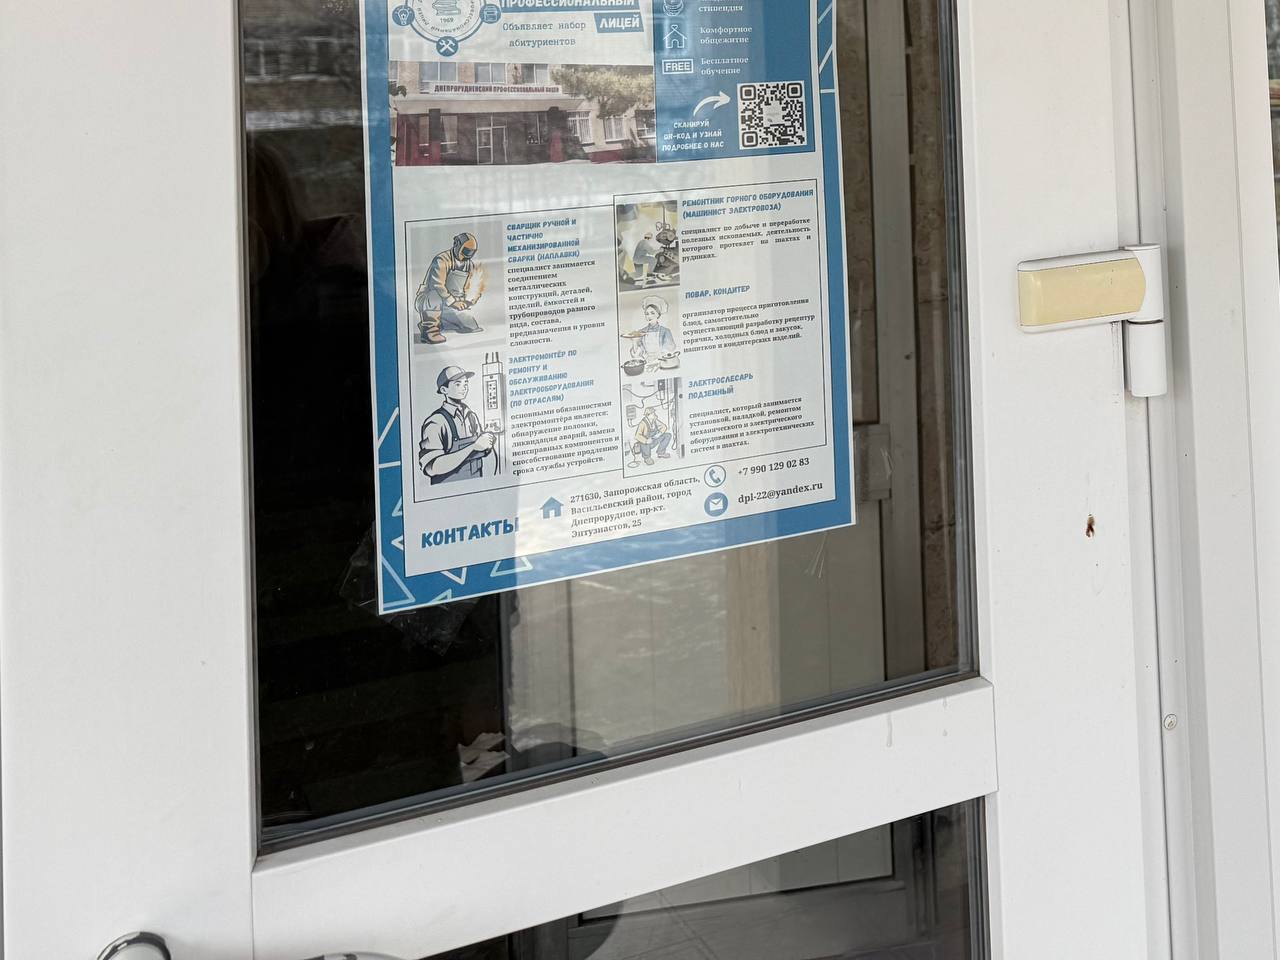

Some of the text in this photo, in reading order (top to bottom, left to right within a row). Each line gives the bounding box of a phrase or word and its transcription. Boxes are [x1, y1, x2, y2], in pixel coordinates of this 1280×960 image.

[503, 21, 586, 31] Объявляет набор
[600, 15, 640, 30] ЛИЦЕЙ
[700, 26, 752, 34] Комфортное
[509, 38, 576, 48] абитуриентов
[700, 36, 749, 45] общежитие
[666, 63, 690, 71] FREE
[701, 57, 748, 65] Бесплатное
[674, 120, 709, 129] СКАНИРУЙ
[662, 143, 702, 152] ПОДРОБНЕЕ
[682, 189, 814, 206] РЕМОНТНИК ГОРНОГО ОБОРУДОВАНИЯ
[682, 203, 782, 219] (МАШИНИСТ ЭЛЕКТРОВОЗА)
[507, 222, 541, 231] СВАРЩИК
[543, 218, 570, 228] РУЧНОЙ
[507, 232, 544, 241] ЧАСТИЧНО
[507, 239, 580, 252] МЕХАНИЗИРОВАННОЙ
[508, 250, 580, 263] СВАРКИ (НАПЛАВКИ)
[713, 285, 750, 296] КОНДИТЕР
[508, 350, 566, 364] ЭЛЕКТРОМОНТЁР
[509, 365, 540, 375] РЕМОНТУ
[509, 372, 567, 385] ОБСЛУЖИВАНИЮ
[688, 373, 754, 388] ЭЛЕКТРОСЛЕСАРЬ
[510, 380, 594, 397] ЭЛЕКТРООБОРУДОВАНИЯ
[688, 386, 734, 399] ПОДЗЕМНЫЙ
[510, 394, 564, 408] (ПО ОТРАСЛЯМ)
[738, 458, 810, 476] +7 990 129 02 83
[570, 491, 602, 503] 271630,
[603, 482, 662, 497] Запорожская
[571, 490, 692, 515] Васильевский район, город
[571, 510, 638, 528] Днепрорудное,
[632, 518, 642, 528] 25
[421, 516, 520, 549] КОНТАКТЫ
